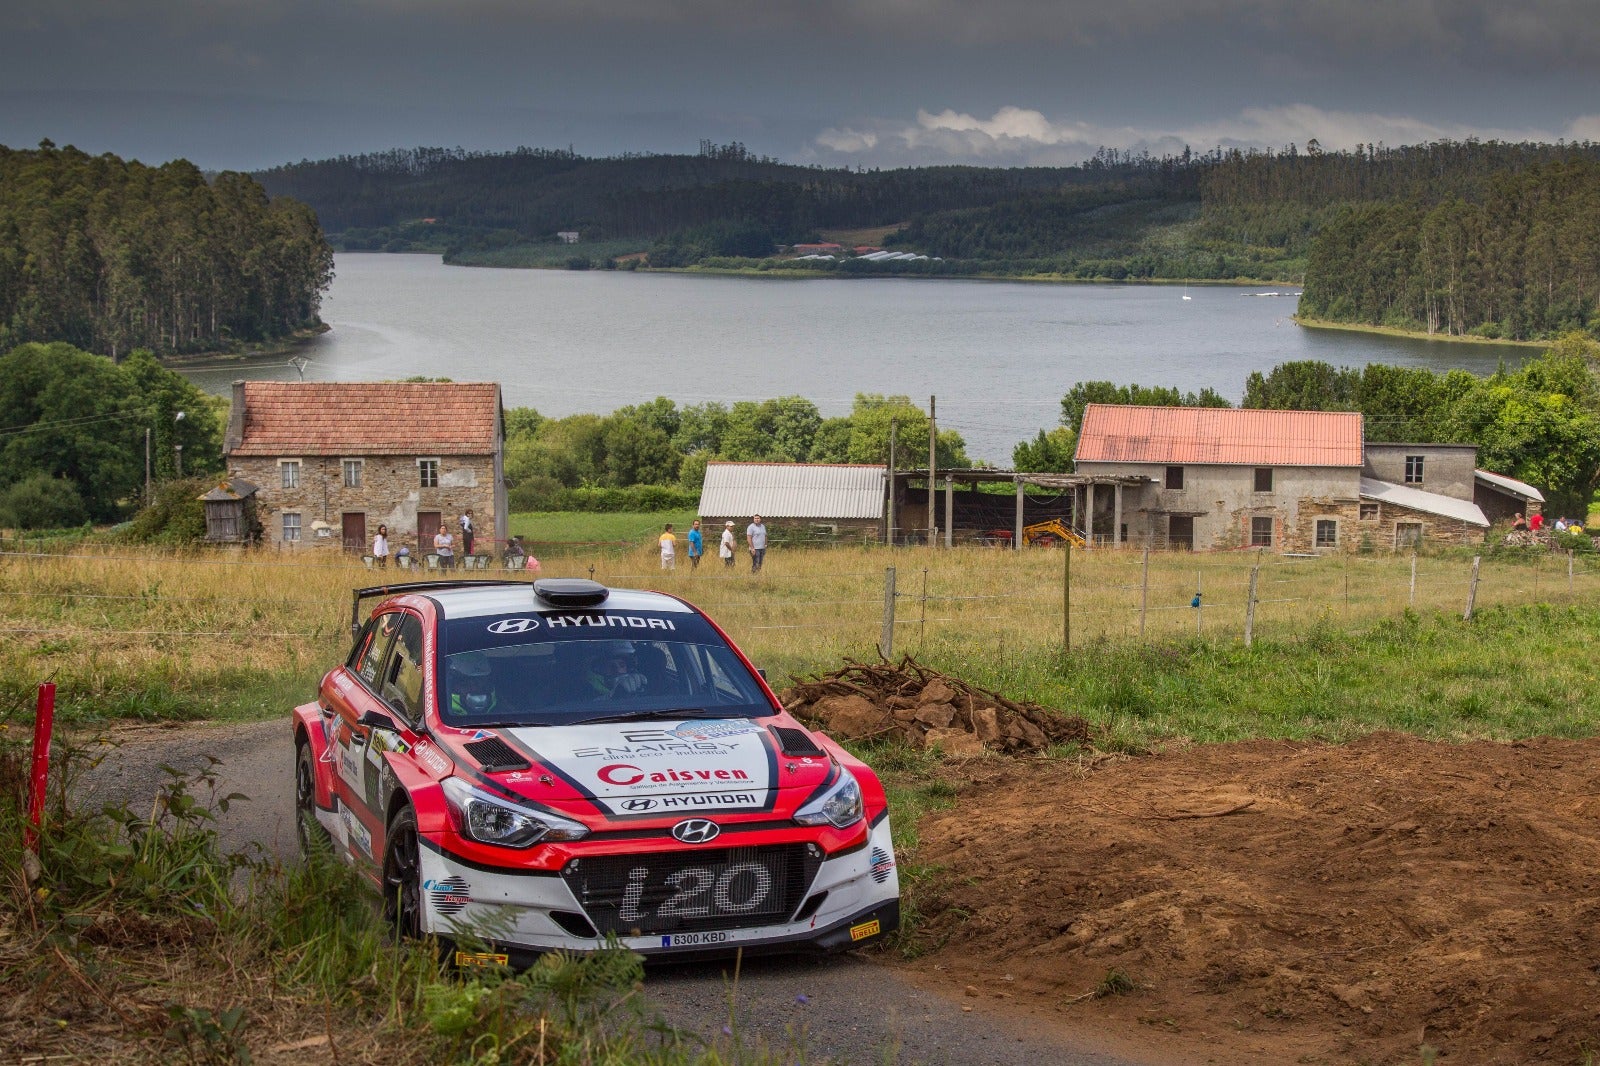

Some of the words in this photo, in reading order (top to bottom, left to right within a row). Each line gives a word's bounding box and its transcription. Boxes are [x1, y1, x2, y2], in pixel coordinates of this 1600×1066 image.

[546, 615, 676, 631] HYUNDAI
[597, 763, 749, 786] Caisven
[663, 793, 756, 807] HYUNDAI
[619, 862, 772, 921] i20
[673, 933, 700, 945] 6300
[701, 932, 727, 943] KBD
[851, 921, 879, 940] PIRELLI
